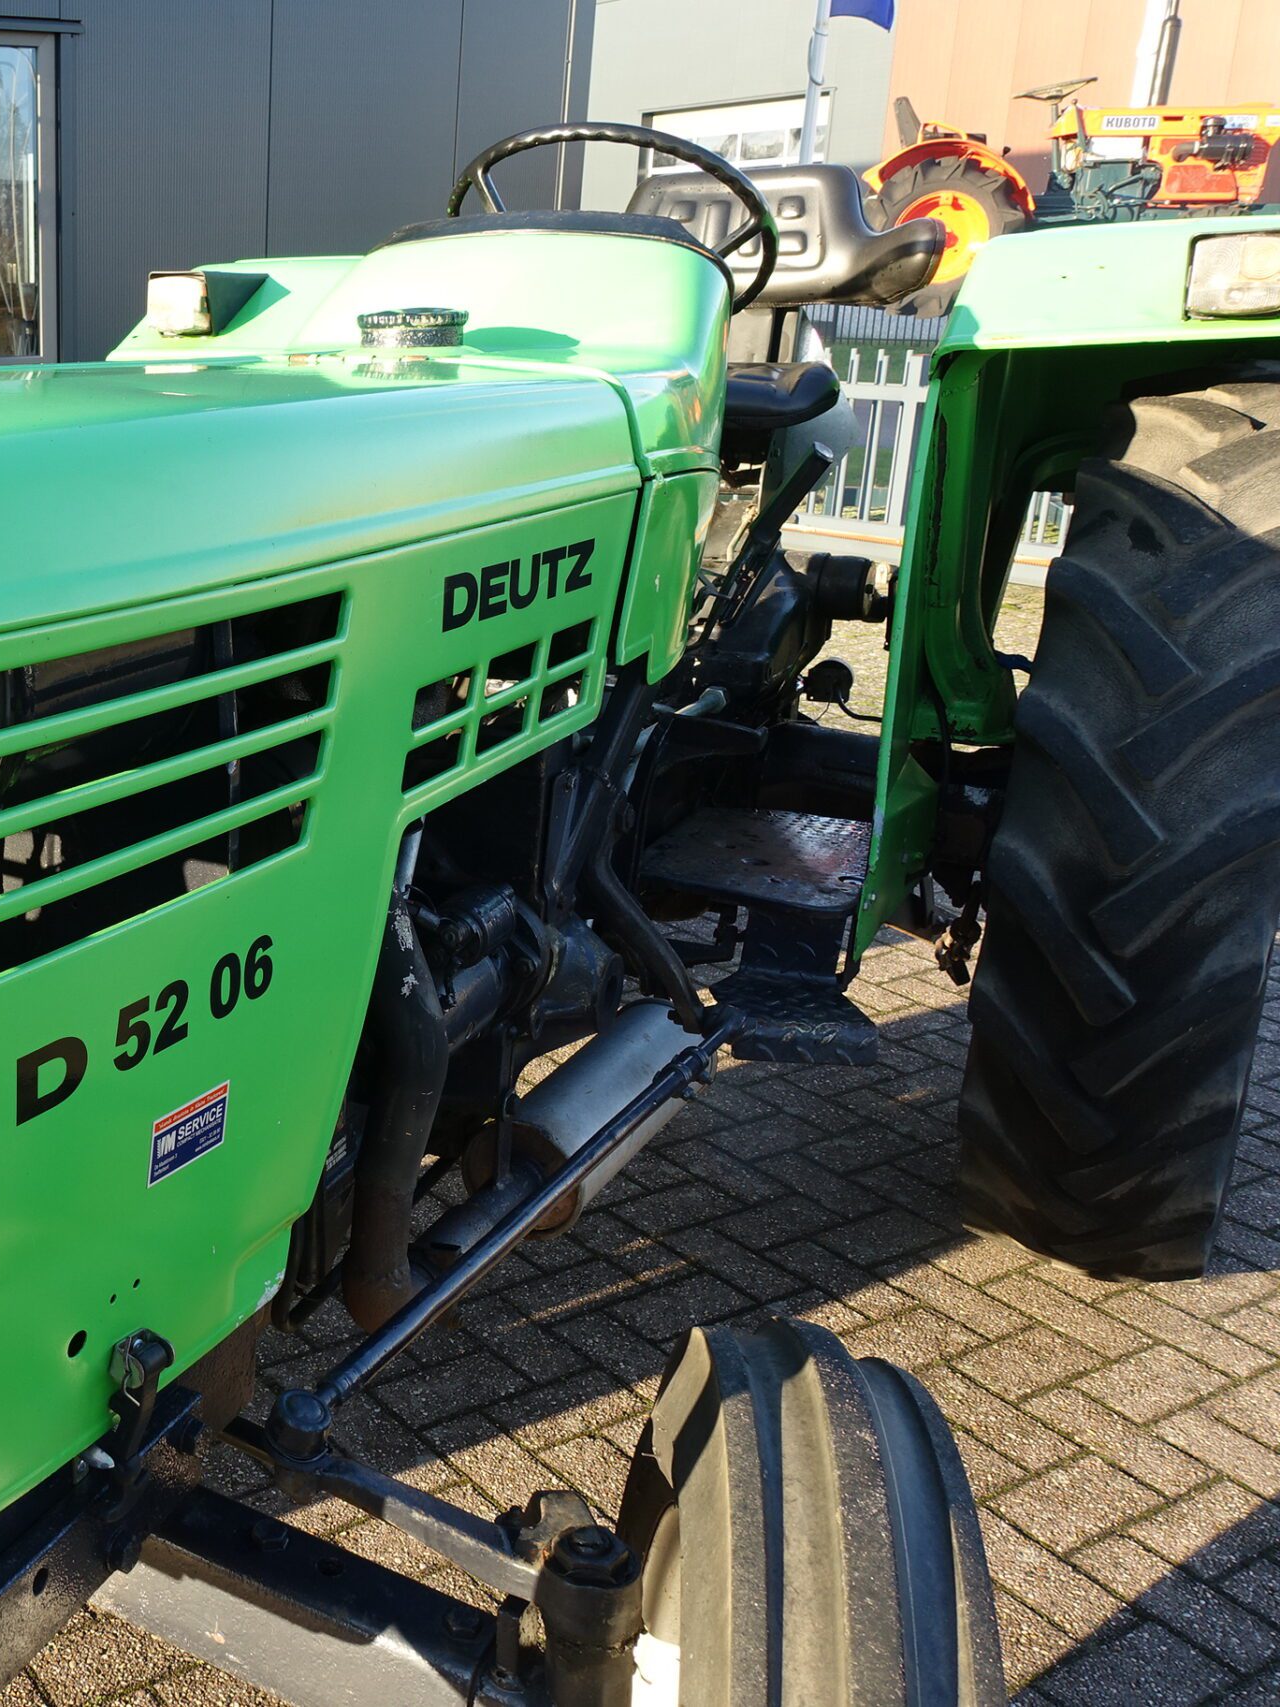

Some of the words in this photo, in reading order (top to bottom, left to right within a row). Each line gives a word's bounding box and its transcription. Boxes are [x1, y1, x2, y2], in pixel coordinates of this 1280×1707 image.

[1106, 117, 1157, 128] KUBOTA
[442, 538, 595, 633] DEUTZ
[16, 1036, 88, 1127] D
[113, 979, 189, 1072] 52
[210, 934, 273, 1020] 06
[177, 1103, 224, 1140] SERVICE
